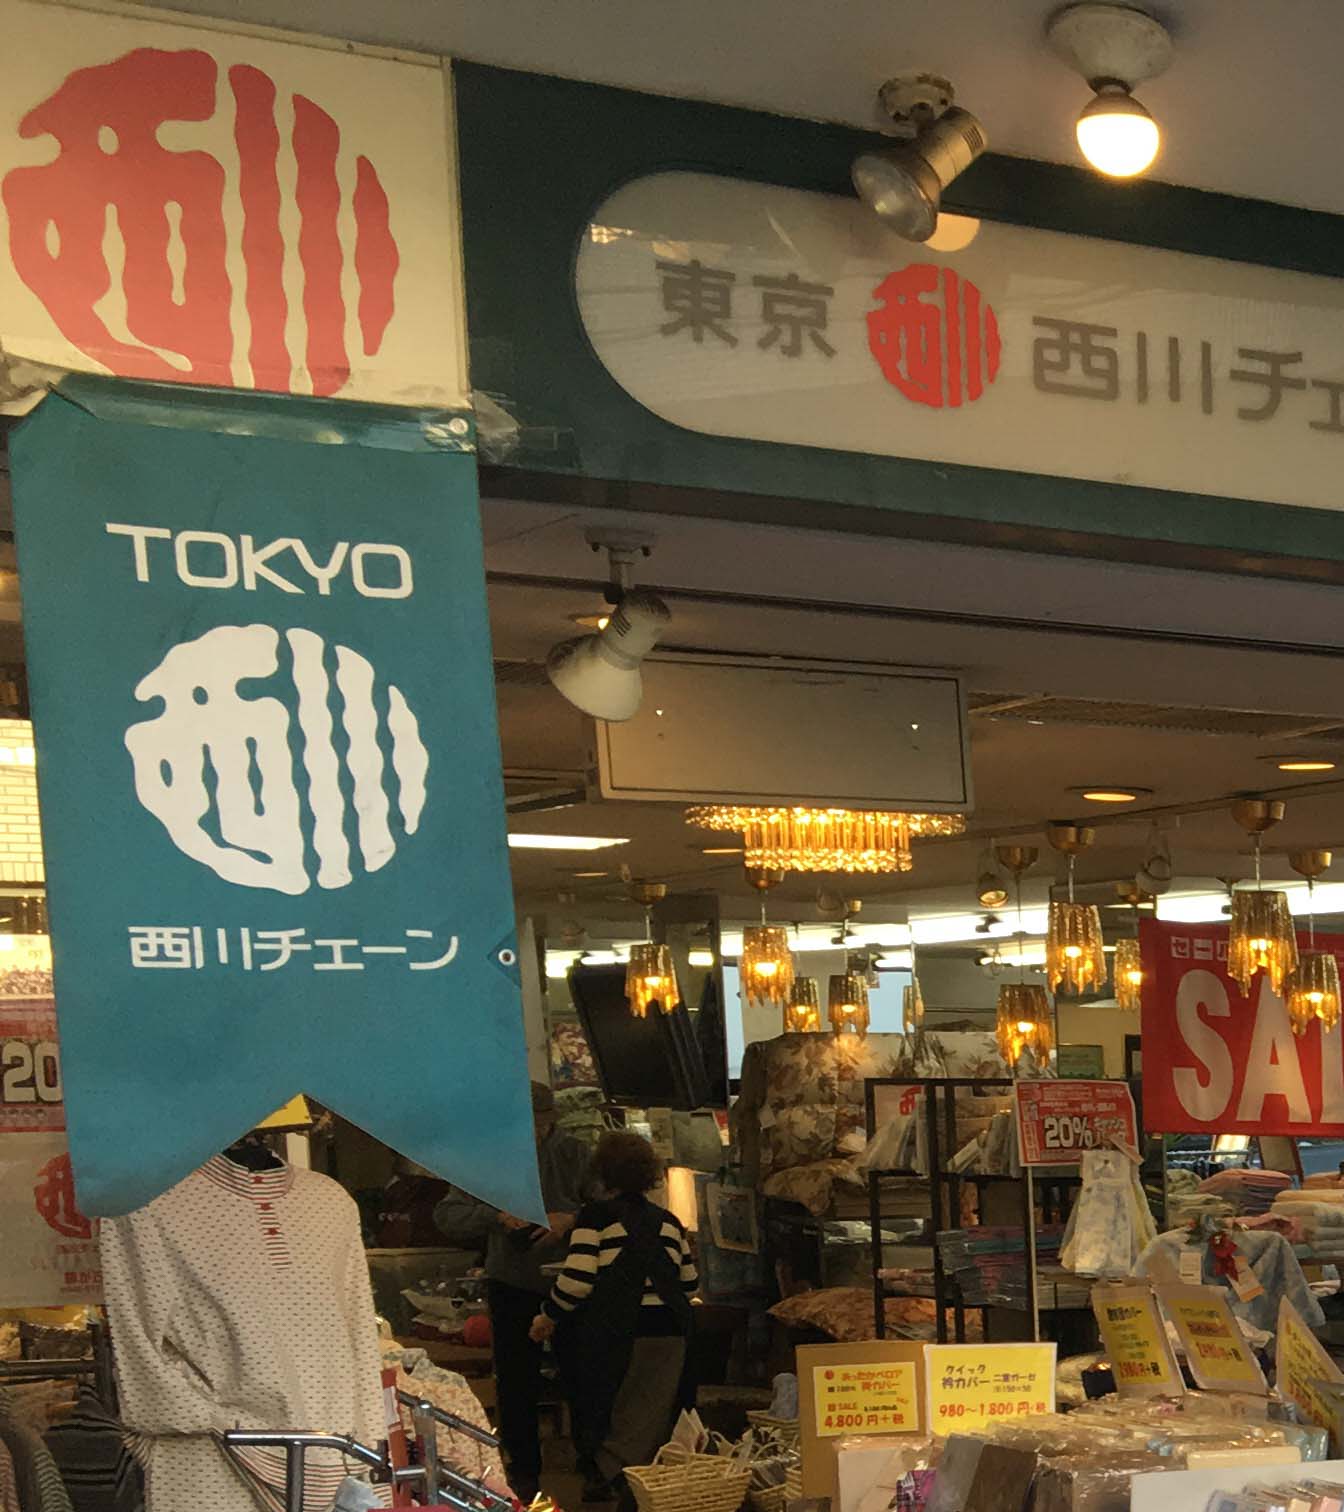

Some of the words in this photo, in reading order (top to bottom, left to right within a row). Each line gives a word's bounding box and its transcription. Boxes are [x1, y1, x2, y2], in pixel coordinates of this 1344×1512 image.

[653, 259, 837, 360] 東京
[105, 522, 414, 599] TOKYO
[127, 926, 460, 971] 西川チェーン
[1045, 1117, 1093, 1148] 20%
